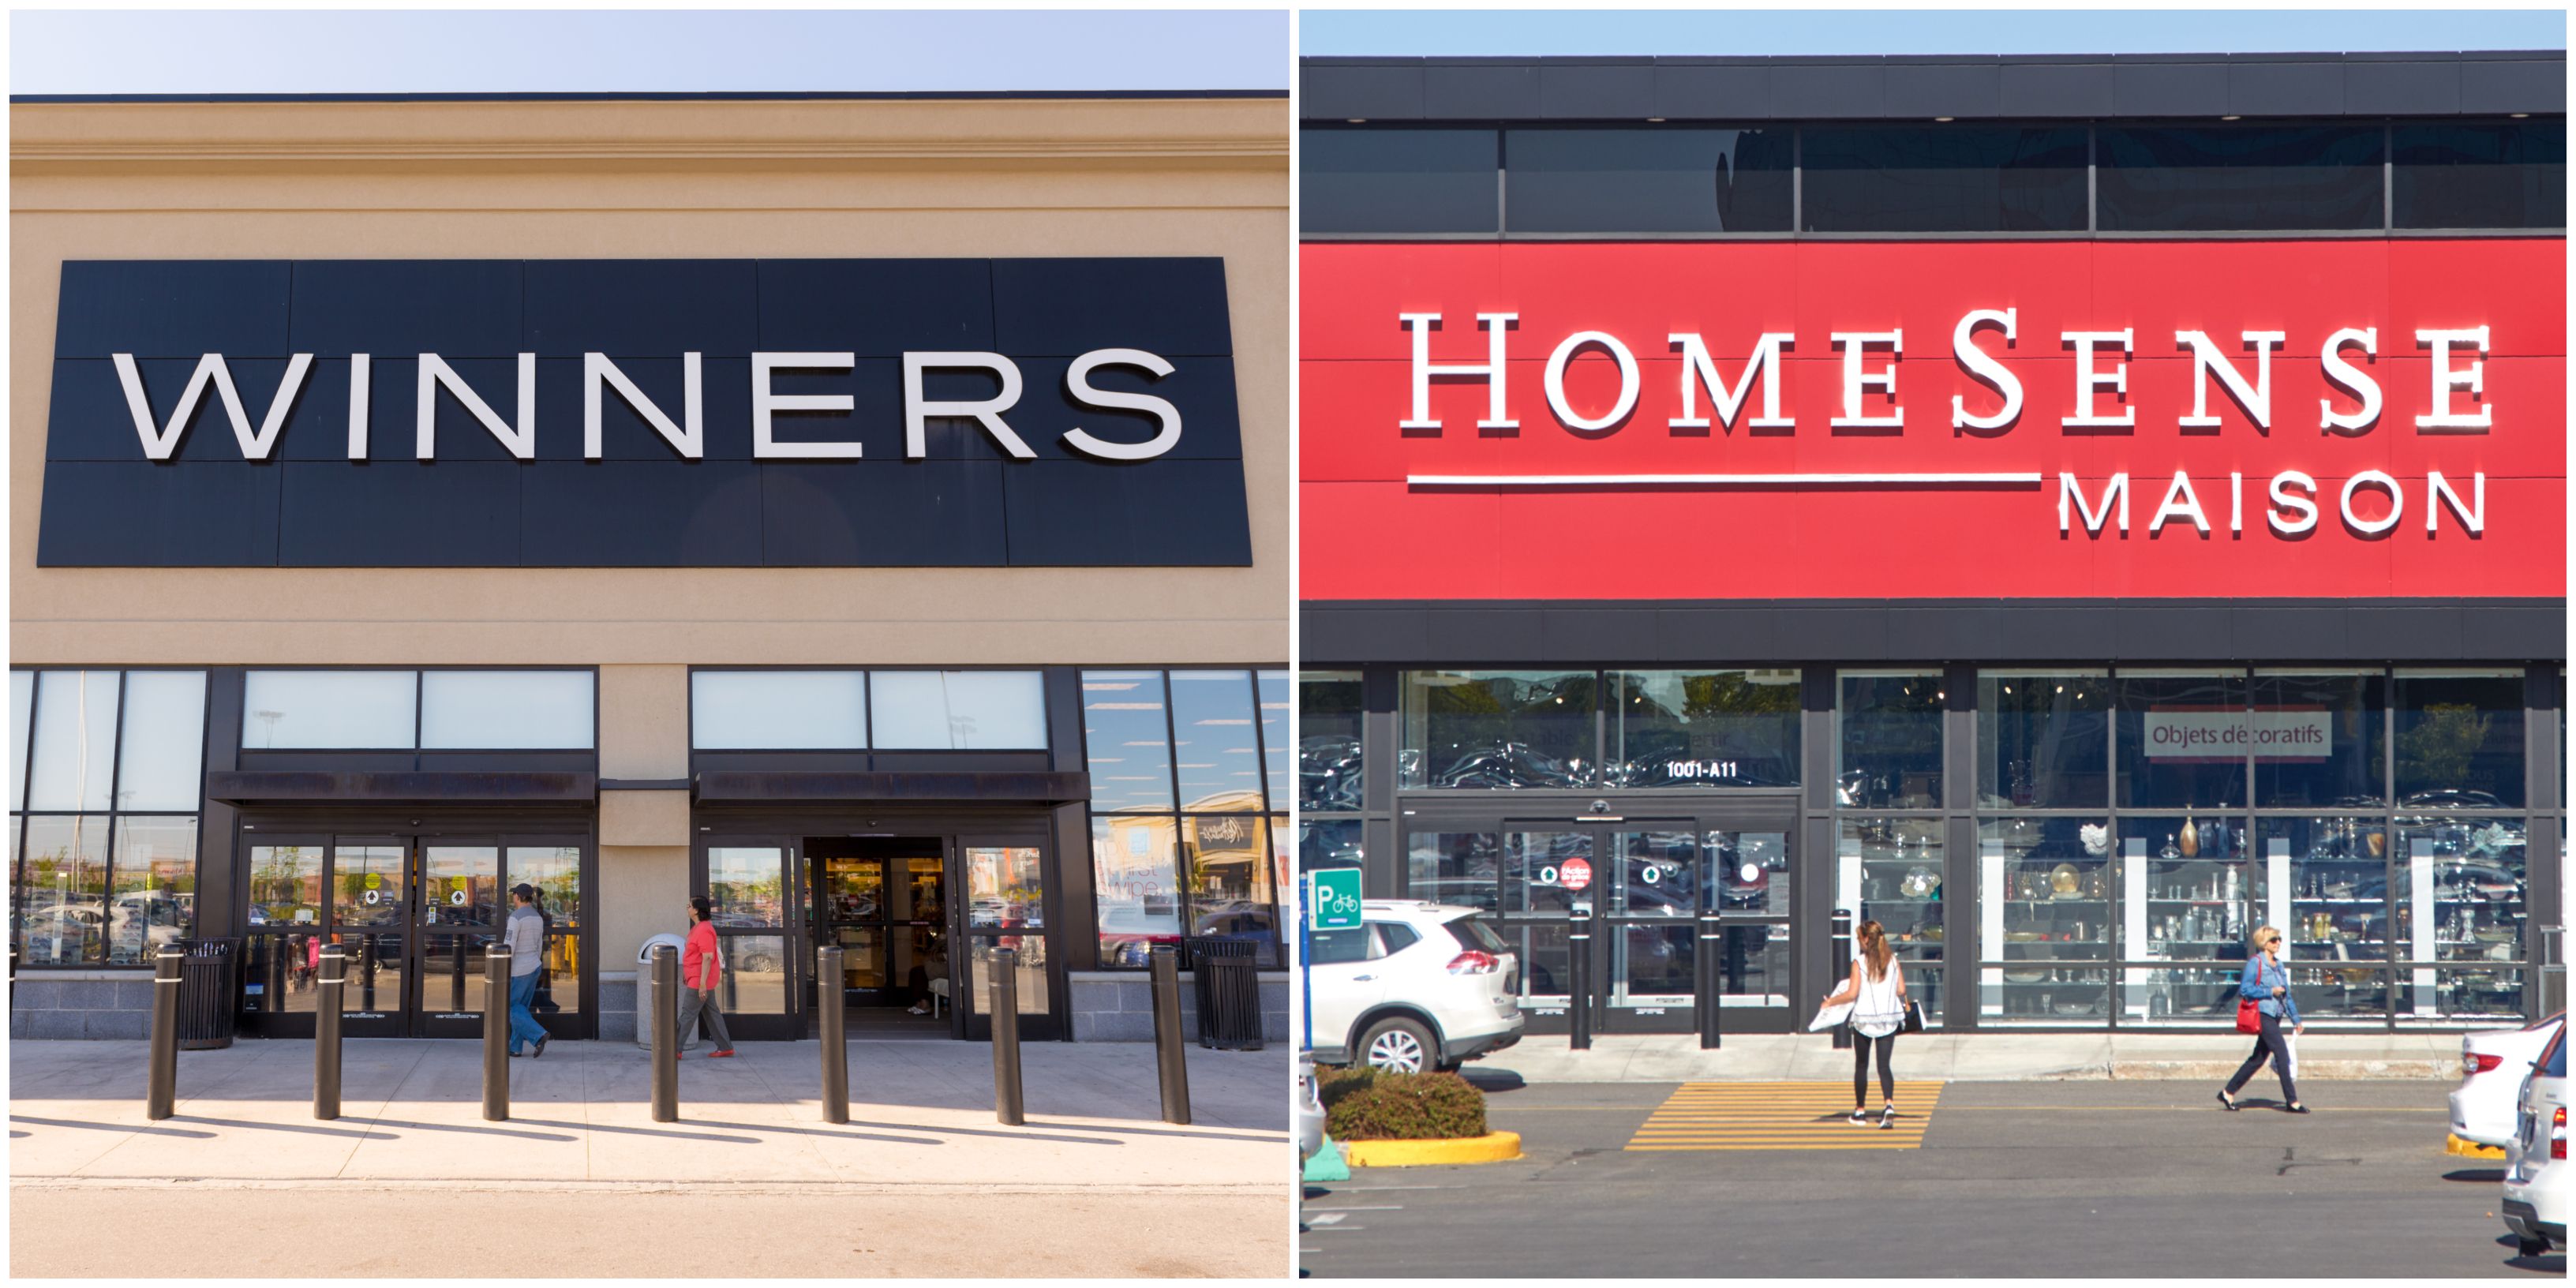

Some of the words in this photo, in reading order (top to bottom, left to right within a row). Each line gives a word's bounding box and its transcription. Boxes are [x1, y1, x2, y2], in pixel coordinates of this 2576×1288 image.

[1399, 308, 2492, 430] HOMESENSE
[112, 348, 1181, 459] WINNERS
[2058, 470, 2484, 533] MAISON
[2153, 724, 2217, 747] Objets
[1667, 761, 1736, 777] 1001-A11
[1318, 886, 1334, 914] P
